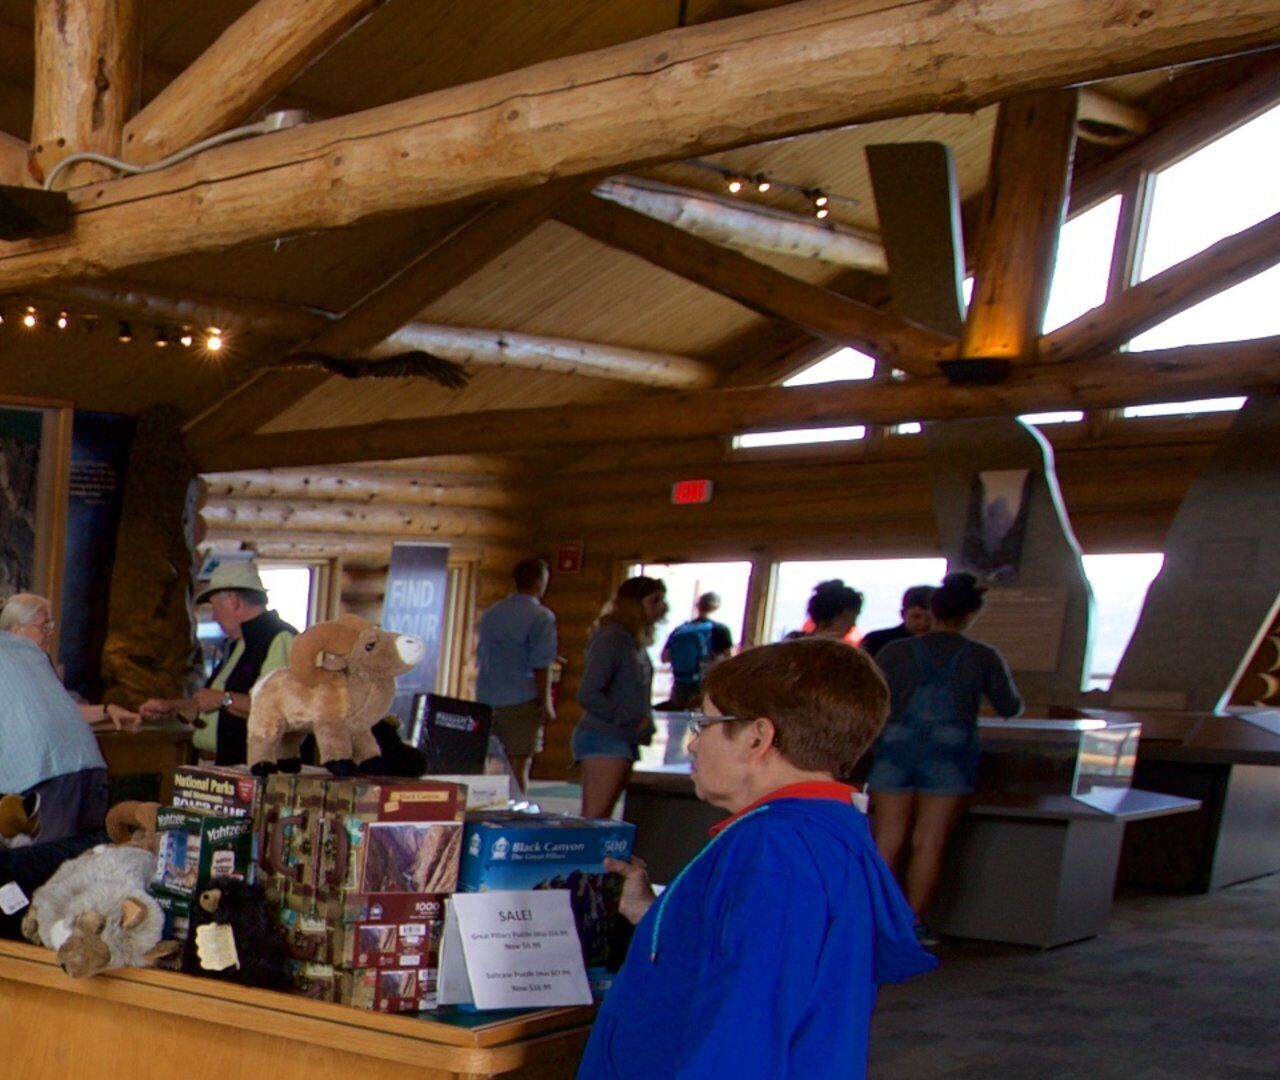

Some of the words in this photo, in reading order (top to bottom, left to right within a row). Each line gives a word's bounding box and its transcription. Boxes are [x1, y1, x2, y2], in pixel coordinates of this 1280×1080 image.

[390, 579, 435, 609] FIND
[174, 773, 210, 792] National
[210, 778, 236, 796] Parks
[206, 824, 249, 842] Yahtzee
[511, 841, 541, 853] Black
[543, 841, 586, 854] Canyon
[603, 840, 628, 852] 500
[415, 901, 440, 912] 1000
[498, 909, 534, 922] SALE!
